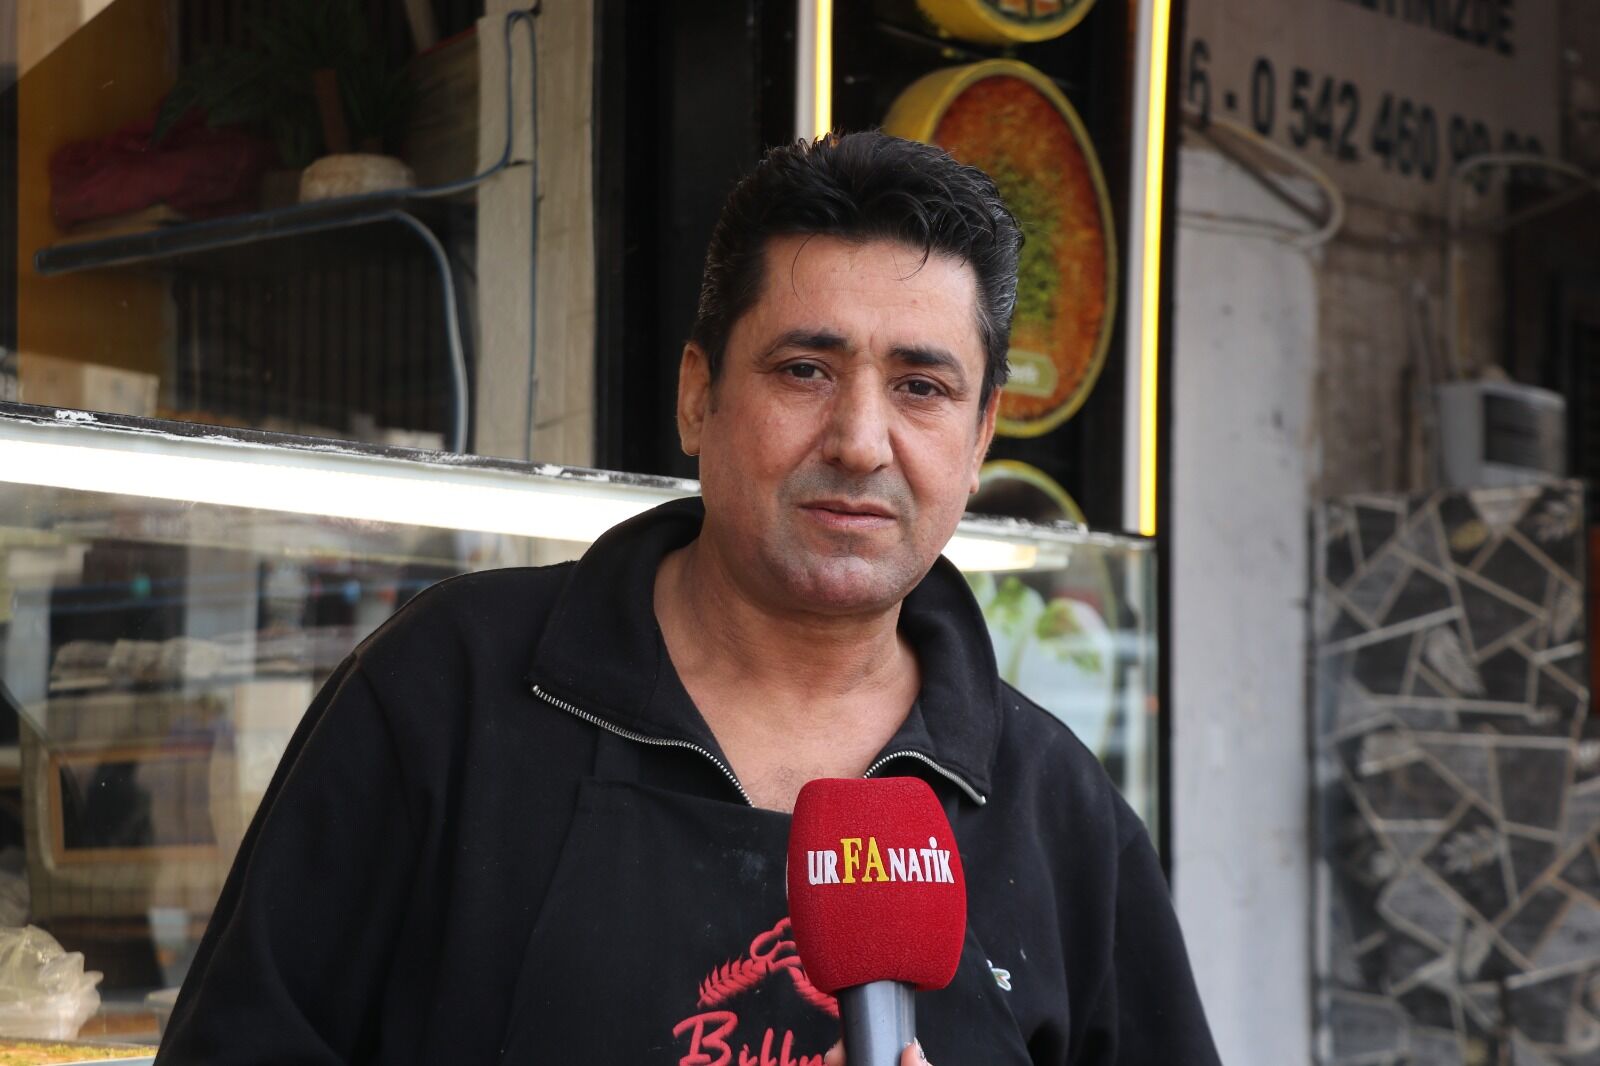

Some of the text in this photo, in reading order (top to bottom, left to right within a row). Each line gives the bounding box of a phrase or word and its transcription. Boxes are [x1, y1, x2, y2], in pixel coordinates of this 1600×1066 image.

[1251, 56, 1276, 137] 0
[1288, 67, 1360, 162] 542
[1371, 91, 1440, 183] 460
